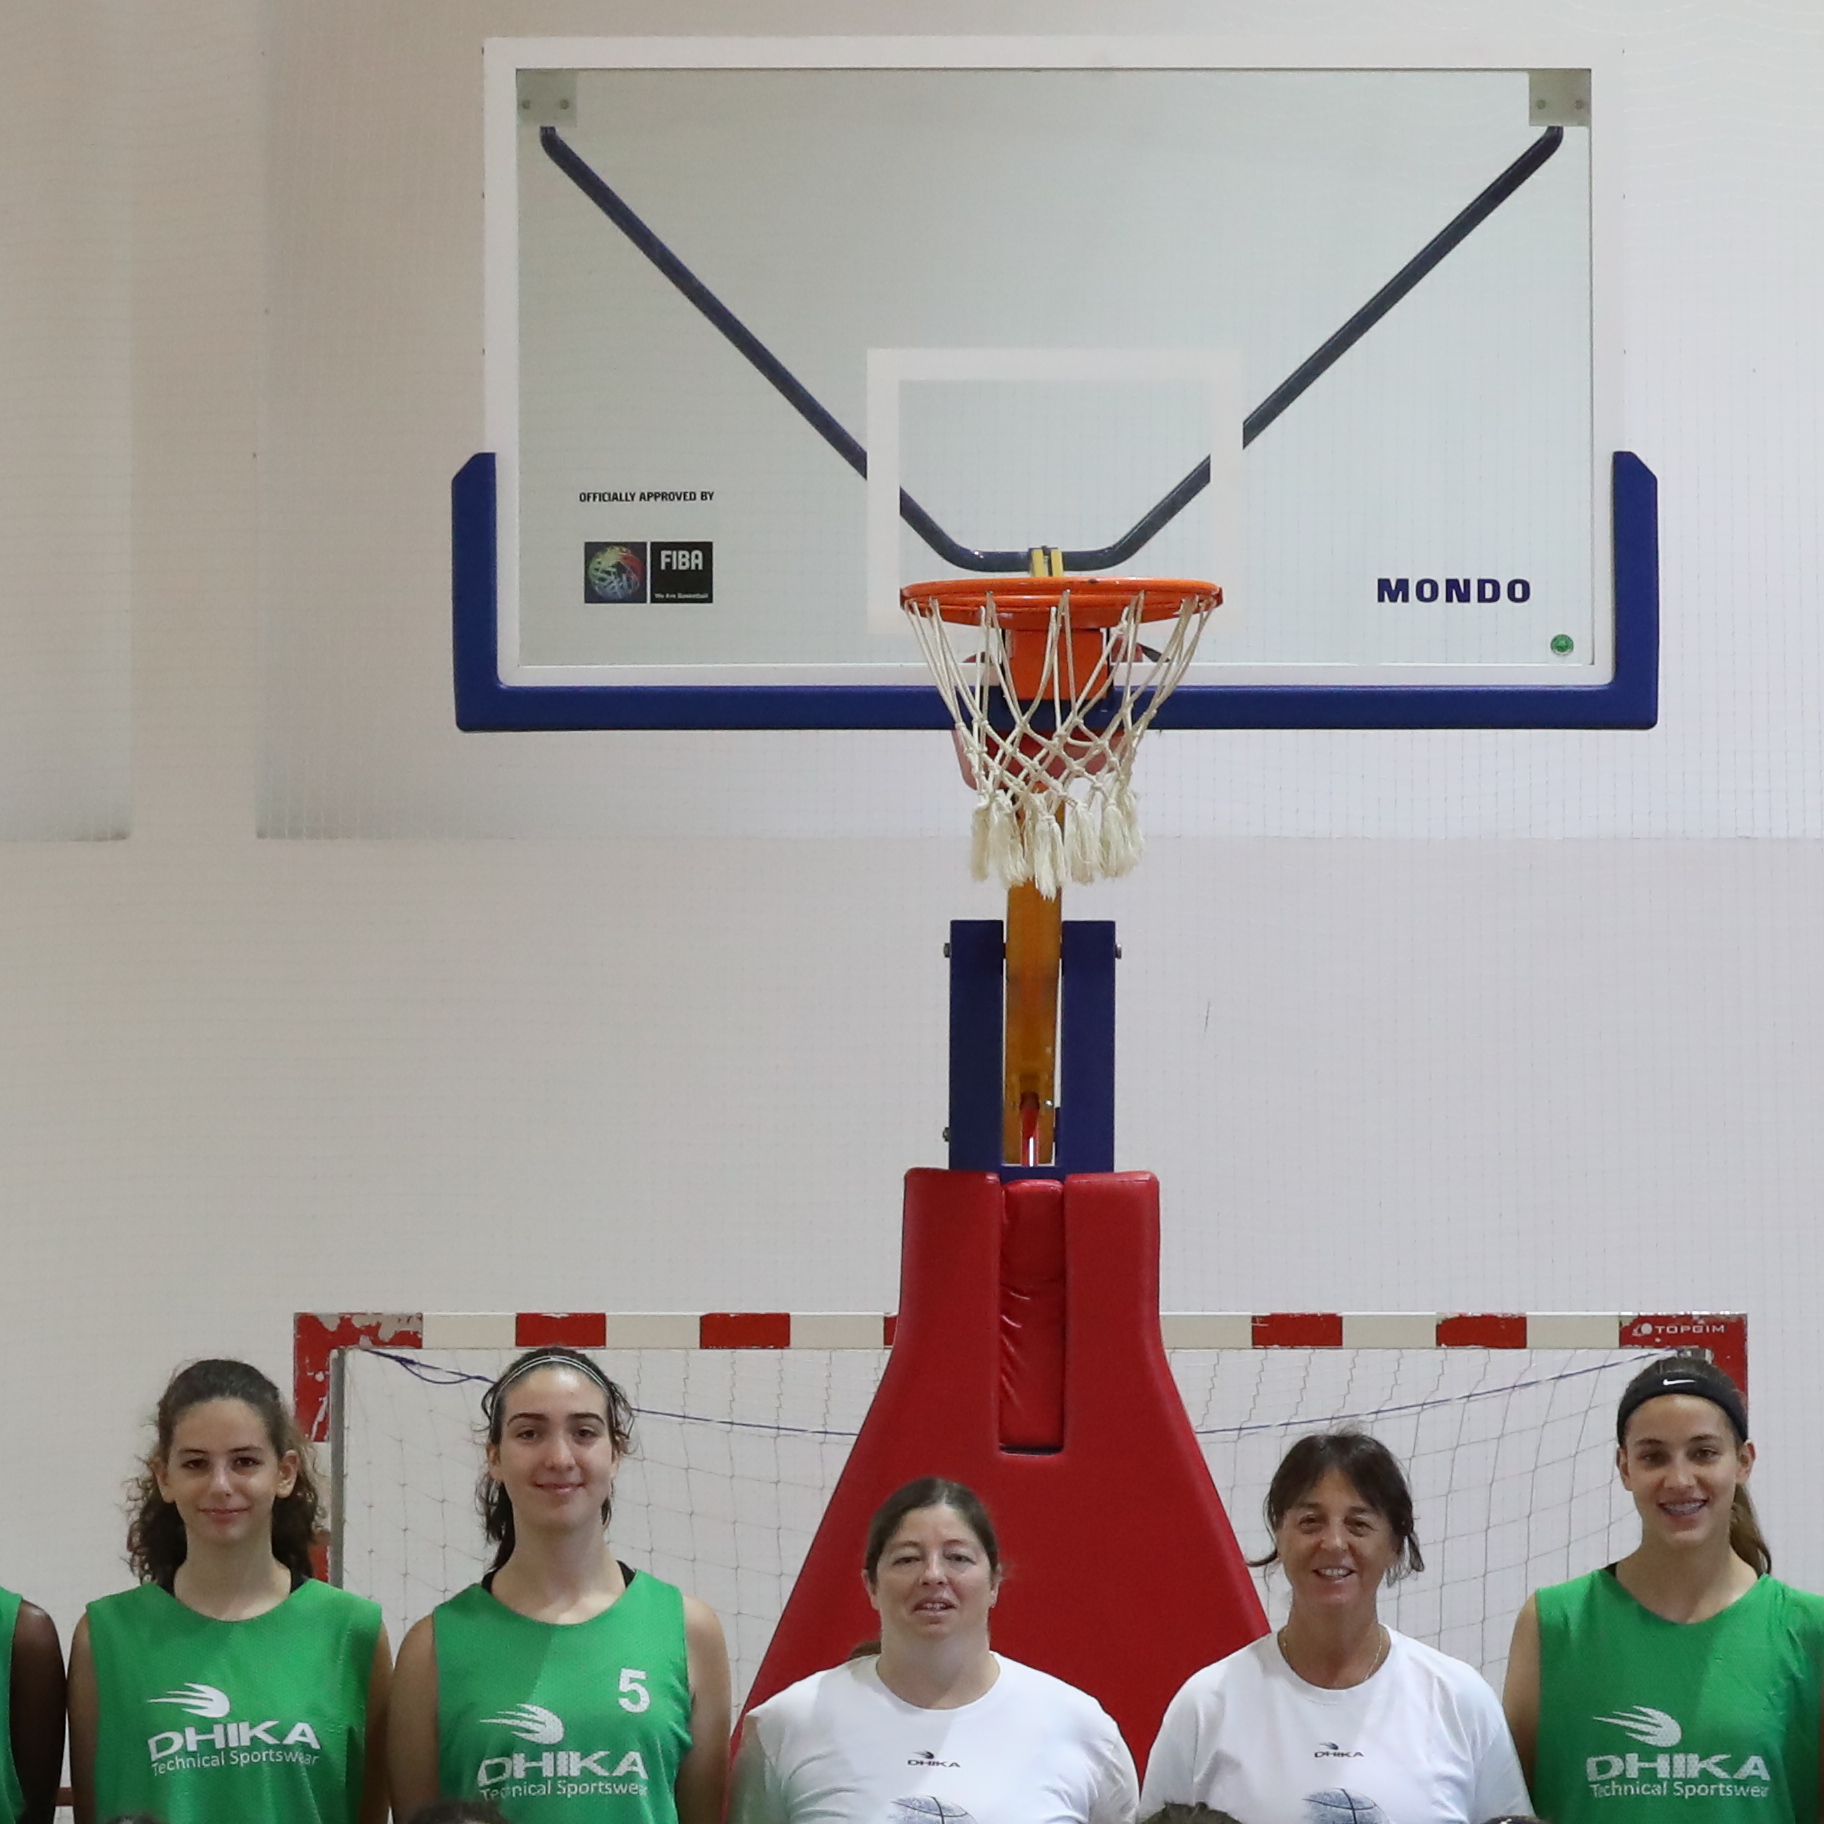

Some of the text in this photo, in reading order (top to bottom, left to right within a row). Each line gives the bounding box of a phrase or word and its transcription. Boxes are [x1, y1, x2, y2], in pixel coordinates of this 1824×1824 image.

[579, 491, 715, 502] OFFICIALLY APPROVED BY
[660, 550, 704, 571] FIBA
[1377, 578, 1531, 603] MONDO
[1654, 1324, 1725, 1334] TOPGIM
[617, 1667, 651, 1713] 5
[147, 1720, 322, 1762] DHIKA
[150, 1749, 320, 1776] Technical Sportswear
[477, 1750, 649, 1787] DHIKA
[907, 1759, 961, 1768] DHIKA
[1586, 1752, 1771, 1781] DHIKA
[1587, 1780, 1770, 1799] Technical Sportswear
